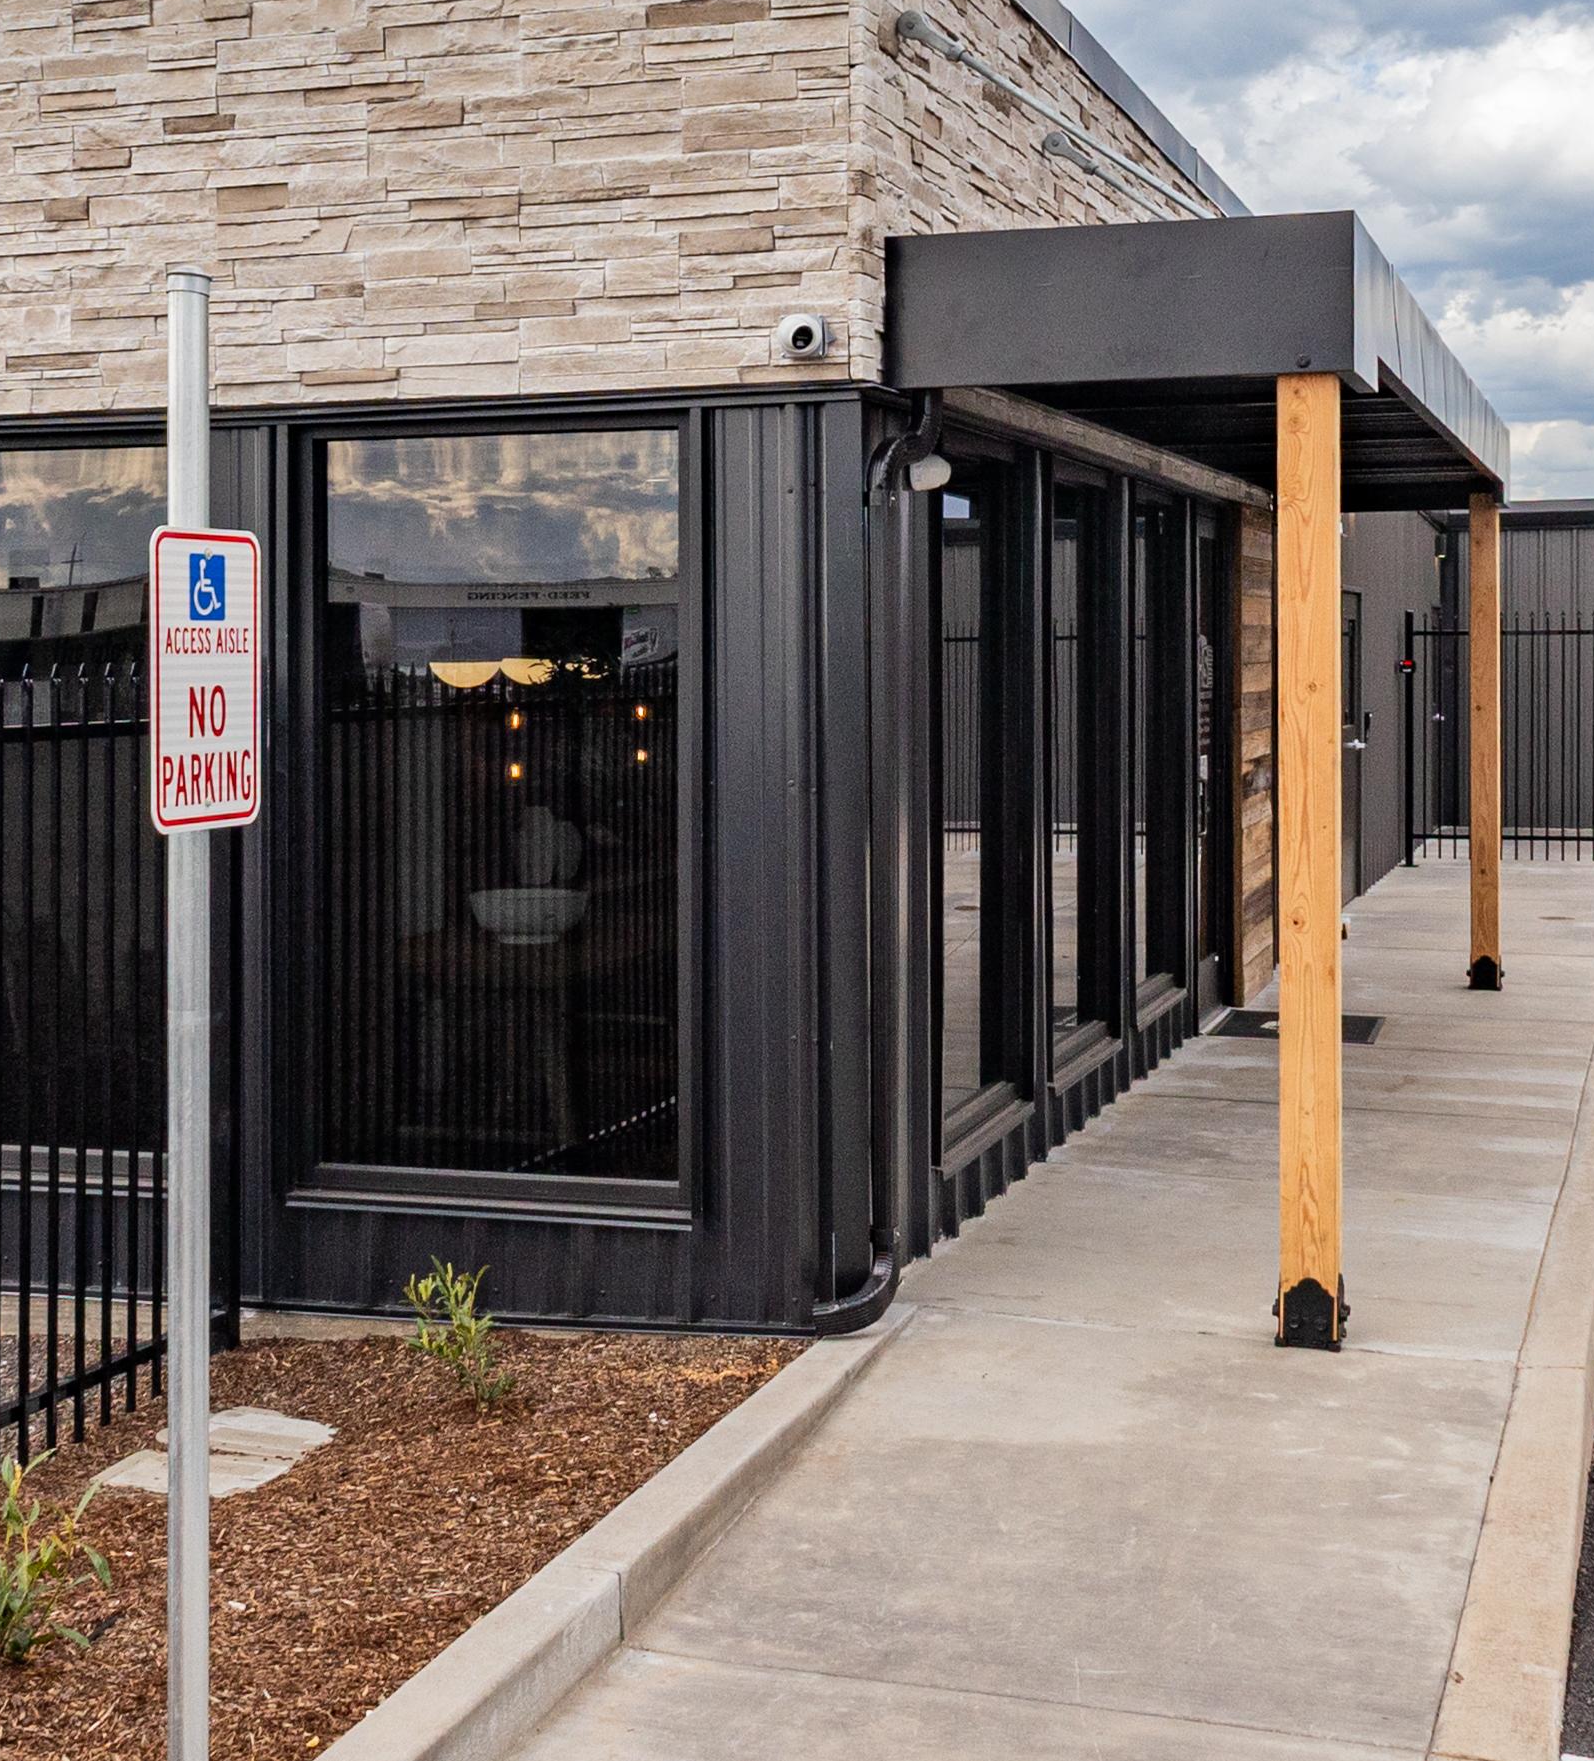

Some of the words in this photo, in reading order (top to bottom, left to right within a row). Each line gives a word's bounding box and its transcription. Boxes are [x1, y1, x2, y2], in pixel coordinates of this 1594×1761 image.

[165, 627, 212, 655] ACCESS
[215, 627, 249, 654] AISLE
[188, 684, 227, 739] NO
[162, 749, 252, 809] PARKING
